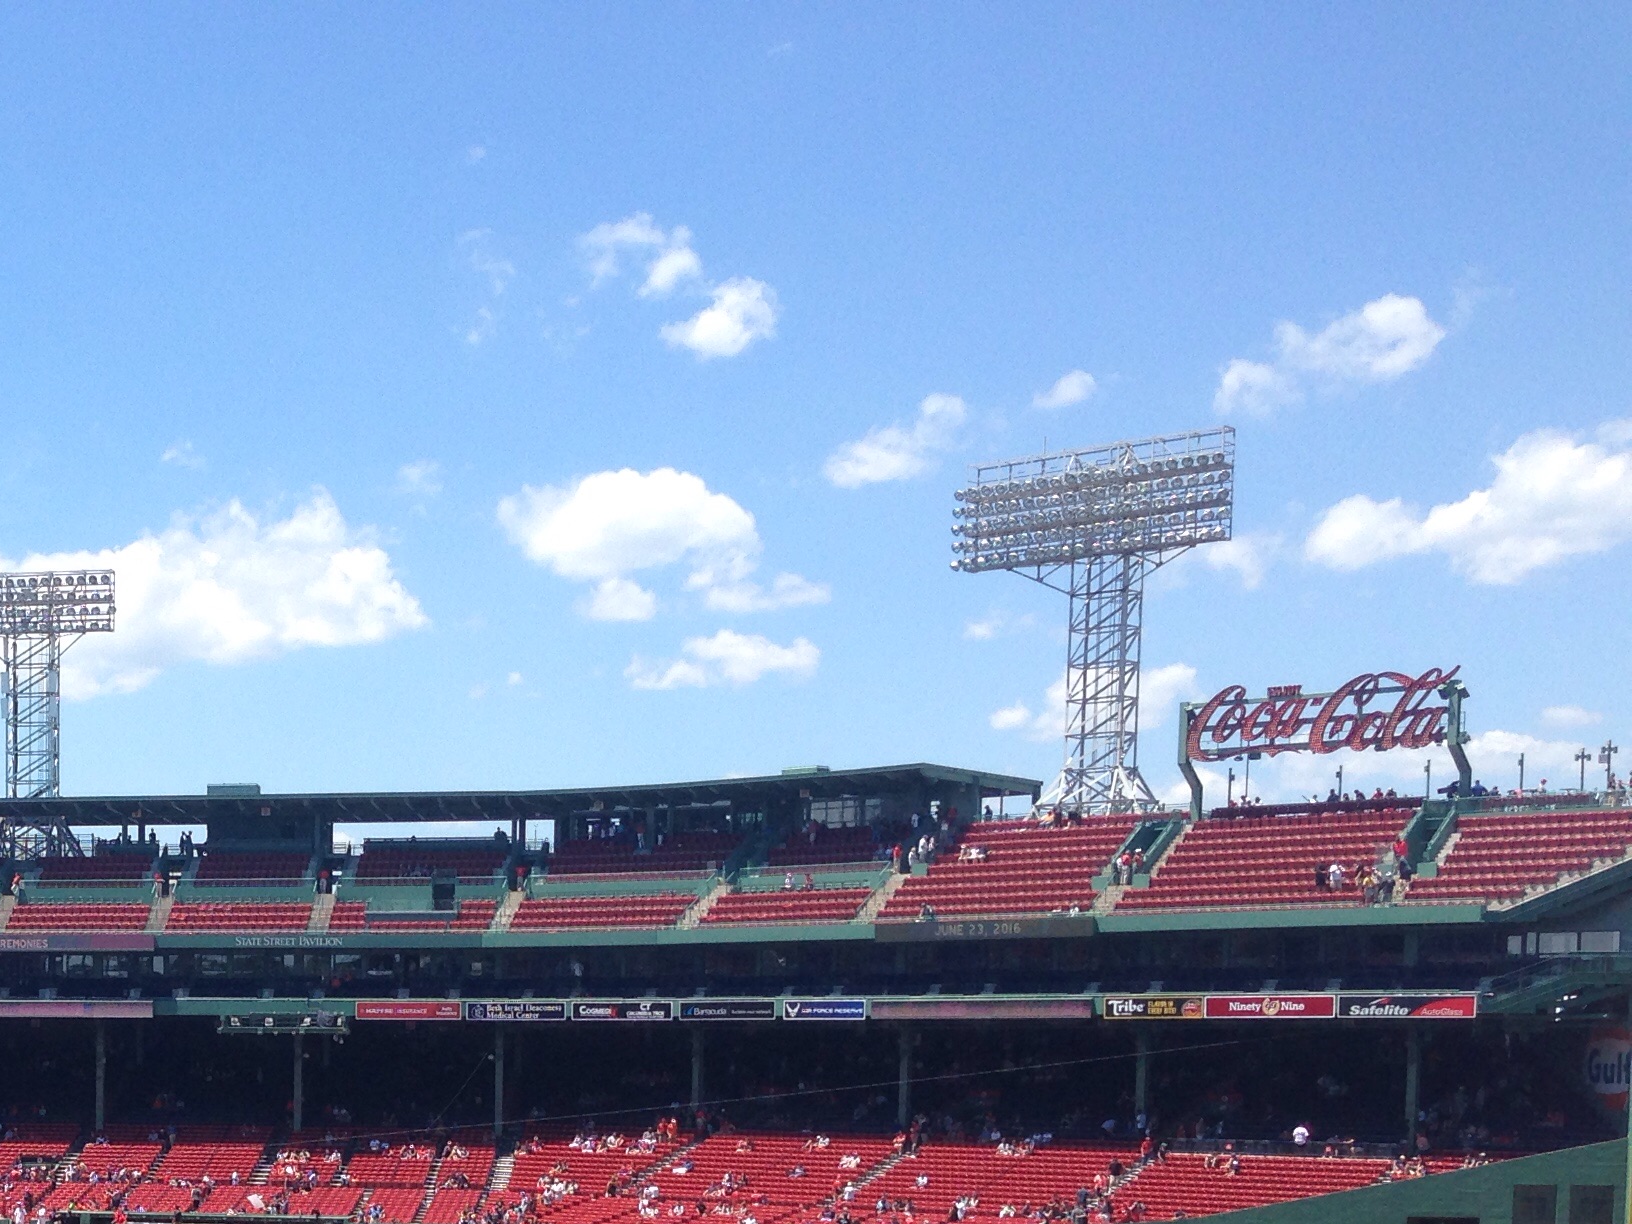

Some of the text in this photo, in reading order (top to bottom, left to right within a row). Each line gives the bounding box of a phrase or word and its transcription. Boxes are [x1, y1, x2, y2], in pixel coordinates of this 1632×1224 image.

[1187, 665, 1460, 762] Coca-Cola
[934, 924, 964, 936] JUNE
[993, 922, 1022, 935] 2016
[235, 936, 343, 947] STATE STREET PAVILION
[693, 1007, 727, 1016] Barracuda
[1108, 999, 1145, 1016] Tribe
[1228, 1001, 1262, 1013] Ninety
[1280, 1001, 1305, 1011] Nine
[1349, 1004, 1410, 1016] Safelite
